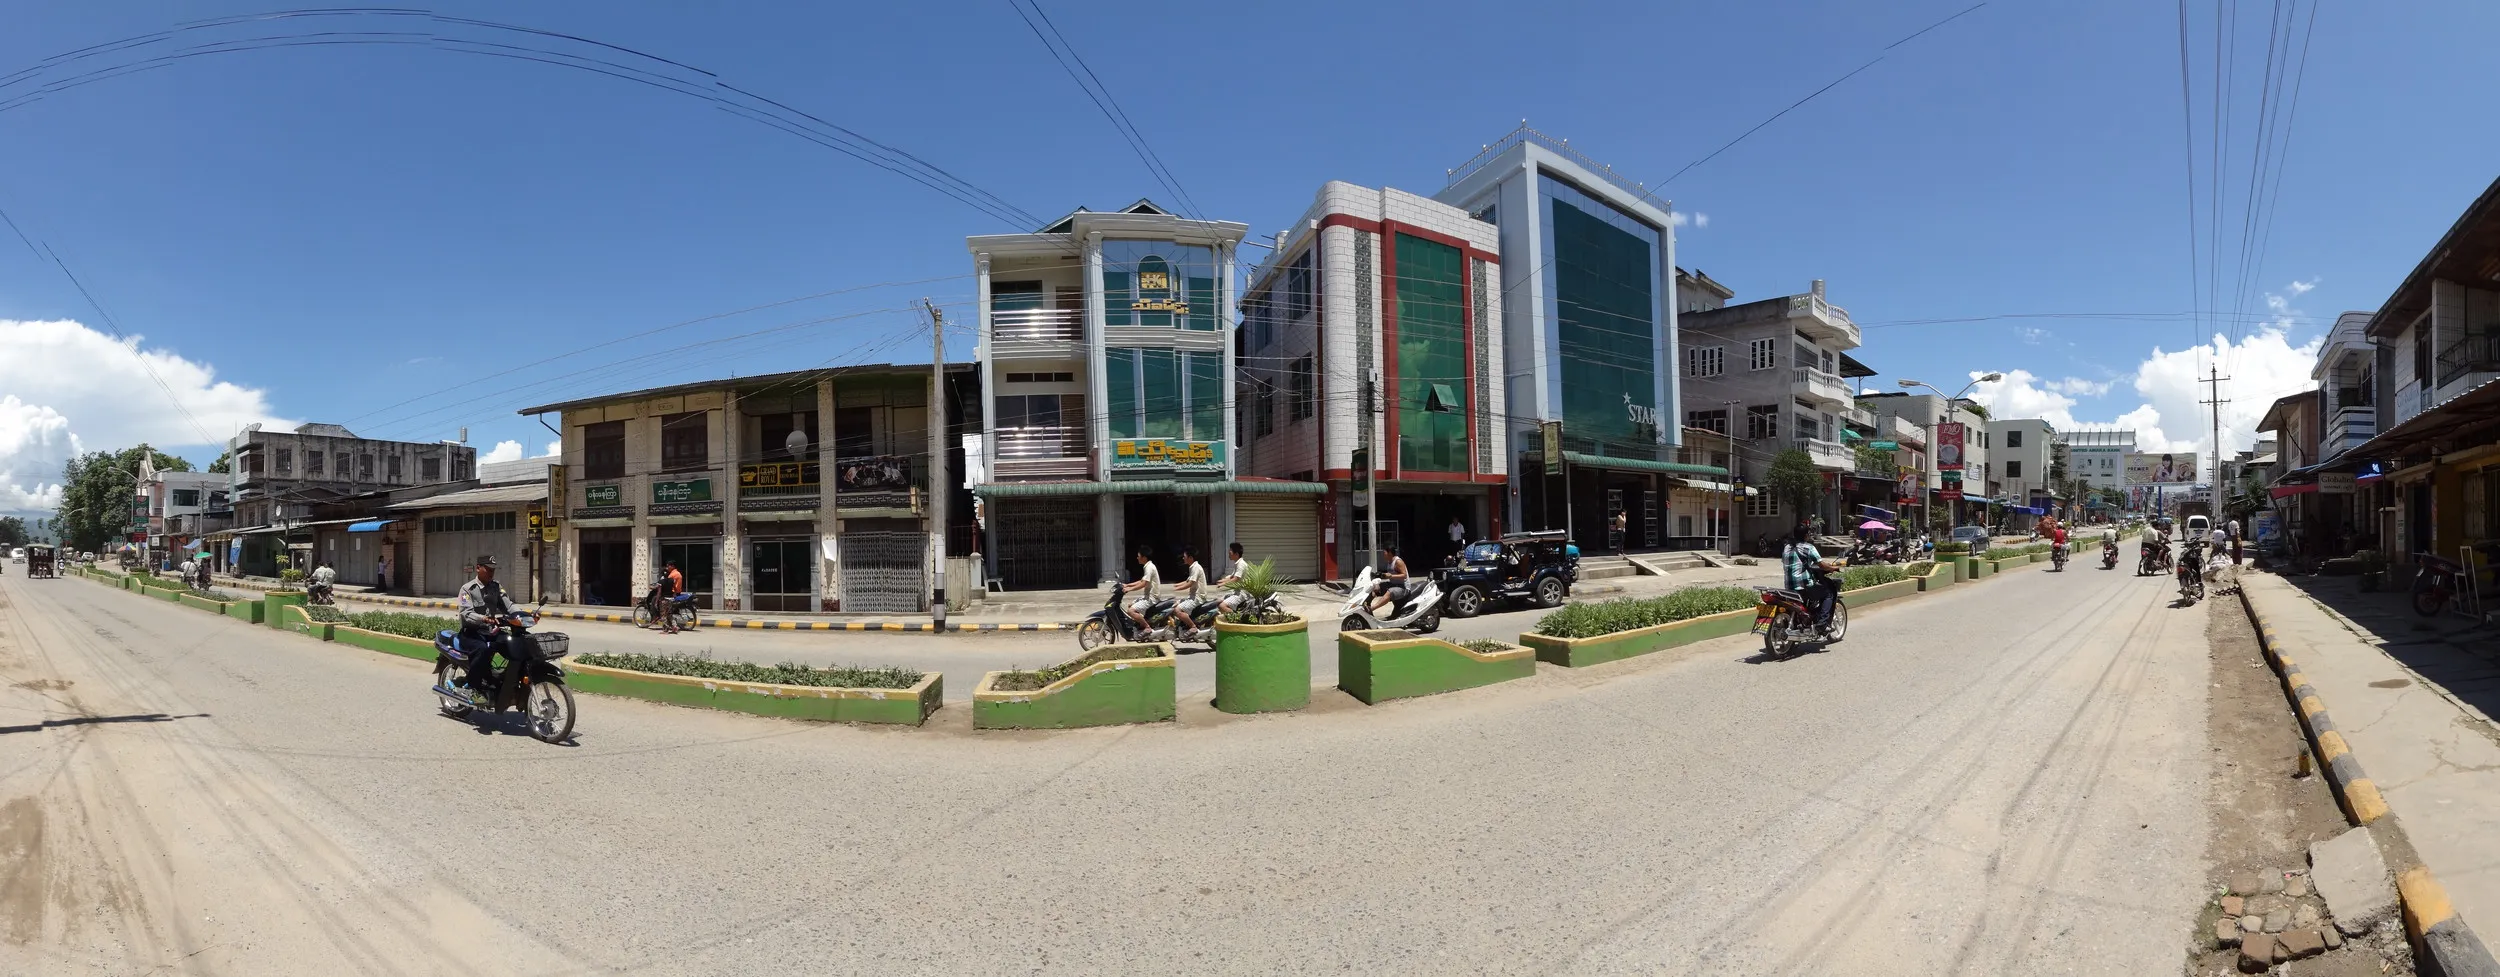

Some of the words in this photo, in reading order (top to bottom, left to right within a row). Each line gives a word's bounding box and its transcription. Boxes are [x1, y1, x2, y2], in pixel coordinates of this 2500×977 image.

[1628, 404, 1656, 426] STAR
[760, 467, 777, 475] GRAND
[760, 475, 777, 484] ROYAL
